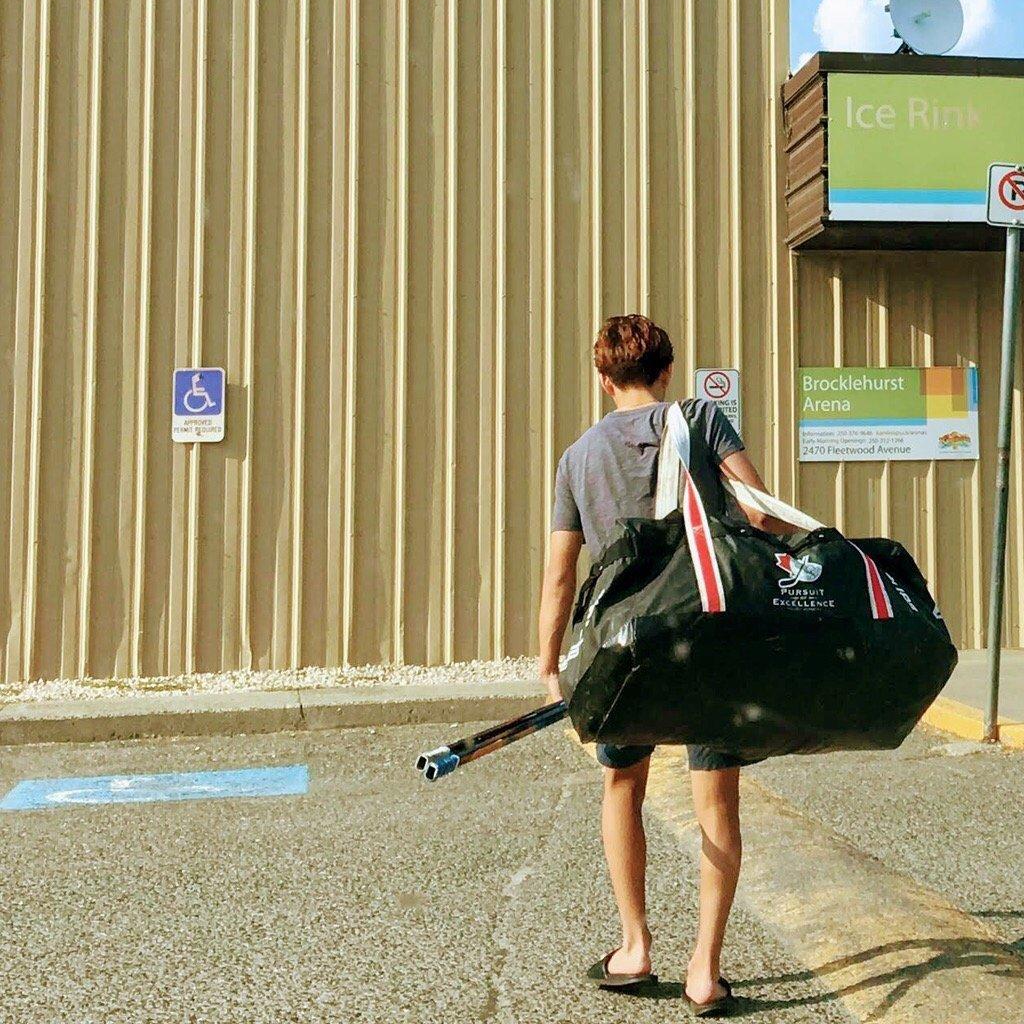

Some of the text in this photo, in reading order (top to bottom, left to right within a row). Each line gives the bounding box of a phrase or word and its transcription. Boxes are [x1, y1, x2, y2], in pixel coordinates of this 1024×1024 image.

[846, 95, 897, 130] Ice
[802, 374, 905, 392] Brocklehurst
[802, 396, 851, 413] Arena
[802, 444, 912, 455] 2470 Fleetwood Avenue
[780, 588, 825, 596] PURSUIT
[772, 598, 835, 608] EXCELLENCE
